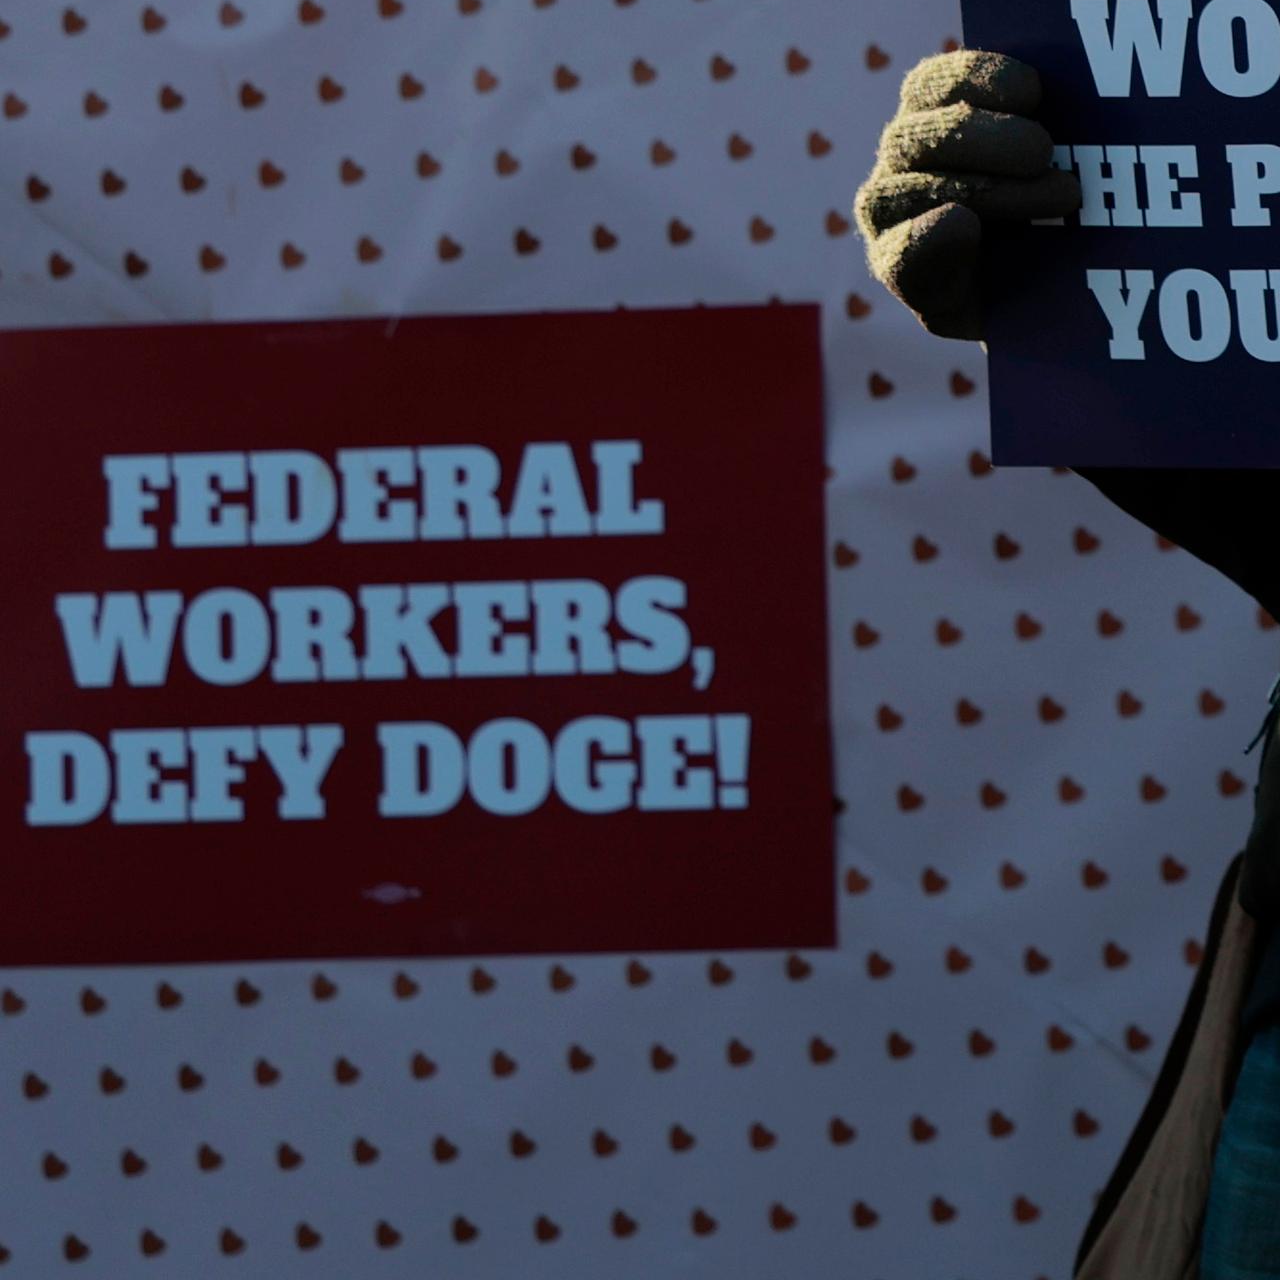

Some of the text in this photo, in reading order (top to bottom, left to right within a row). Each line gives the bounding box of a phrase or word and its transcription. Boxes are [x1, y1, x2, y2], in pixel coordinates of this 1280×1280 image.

[101, 439, 666, 551] FEDERAL
[54, 573, 716, 691] WORKERS,
[23, 712, 752, 828] DEFY DOGE!
